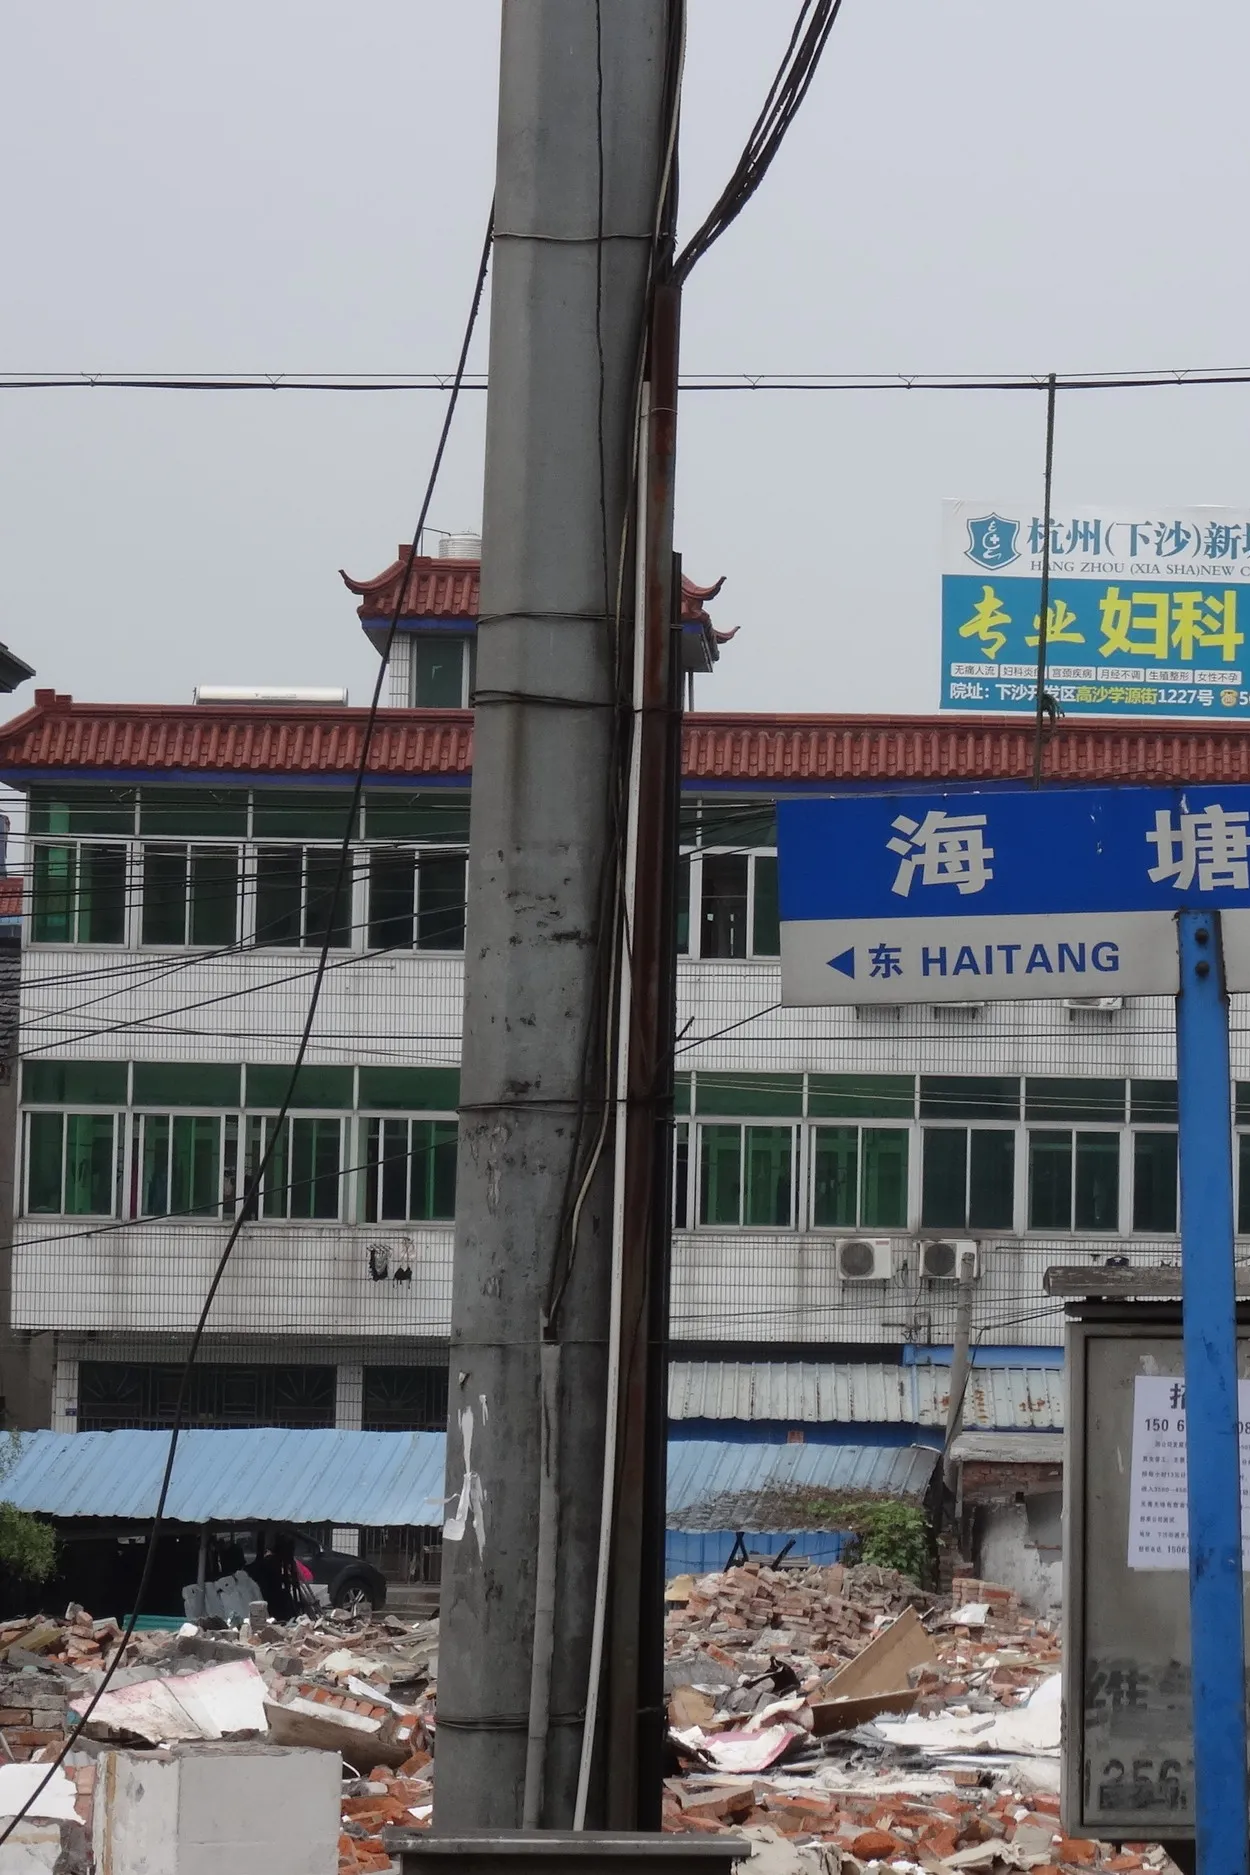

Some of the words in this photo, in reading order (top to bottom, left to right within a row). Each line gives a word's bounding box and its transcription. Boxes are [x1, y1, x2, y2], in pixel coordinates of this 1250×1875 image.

[1080, 562, 1125, 574] ZHOU
[954, 664, 996, 676] 无痛人流
[1052, 668, 1093, 679] 宫颈疾病
[1100, 669, 1141, 680] 月经不调
[868, 943, 904, 980] 东
[922, 942, 1120, 977] HAITANG
[1145, 1418, 1169, 1432] 150
